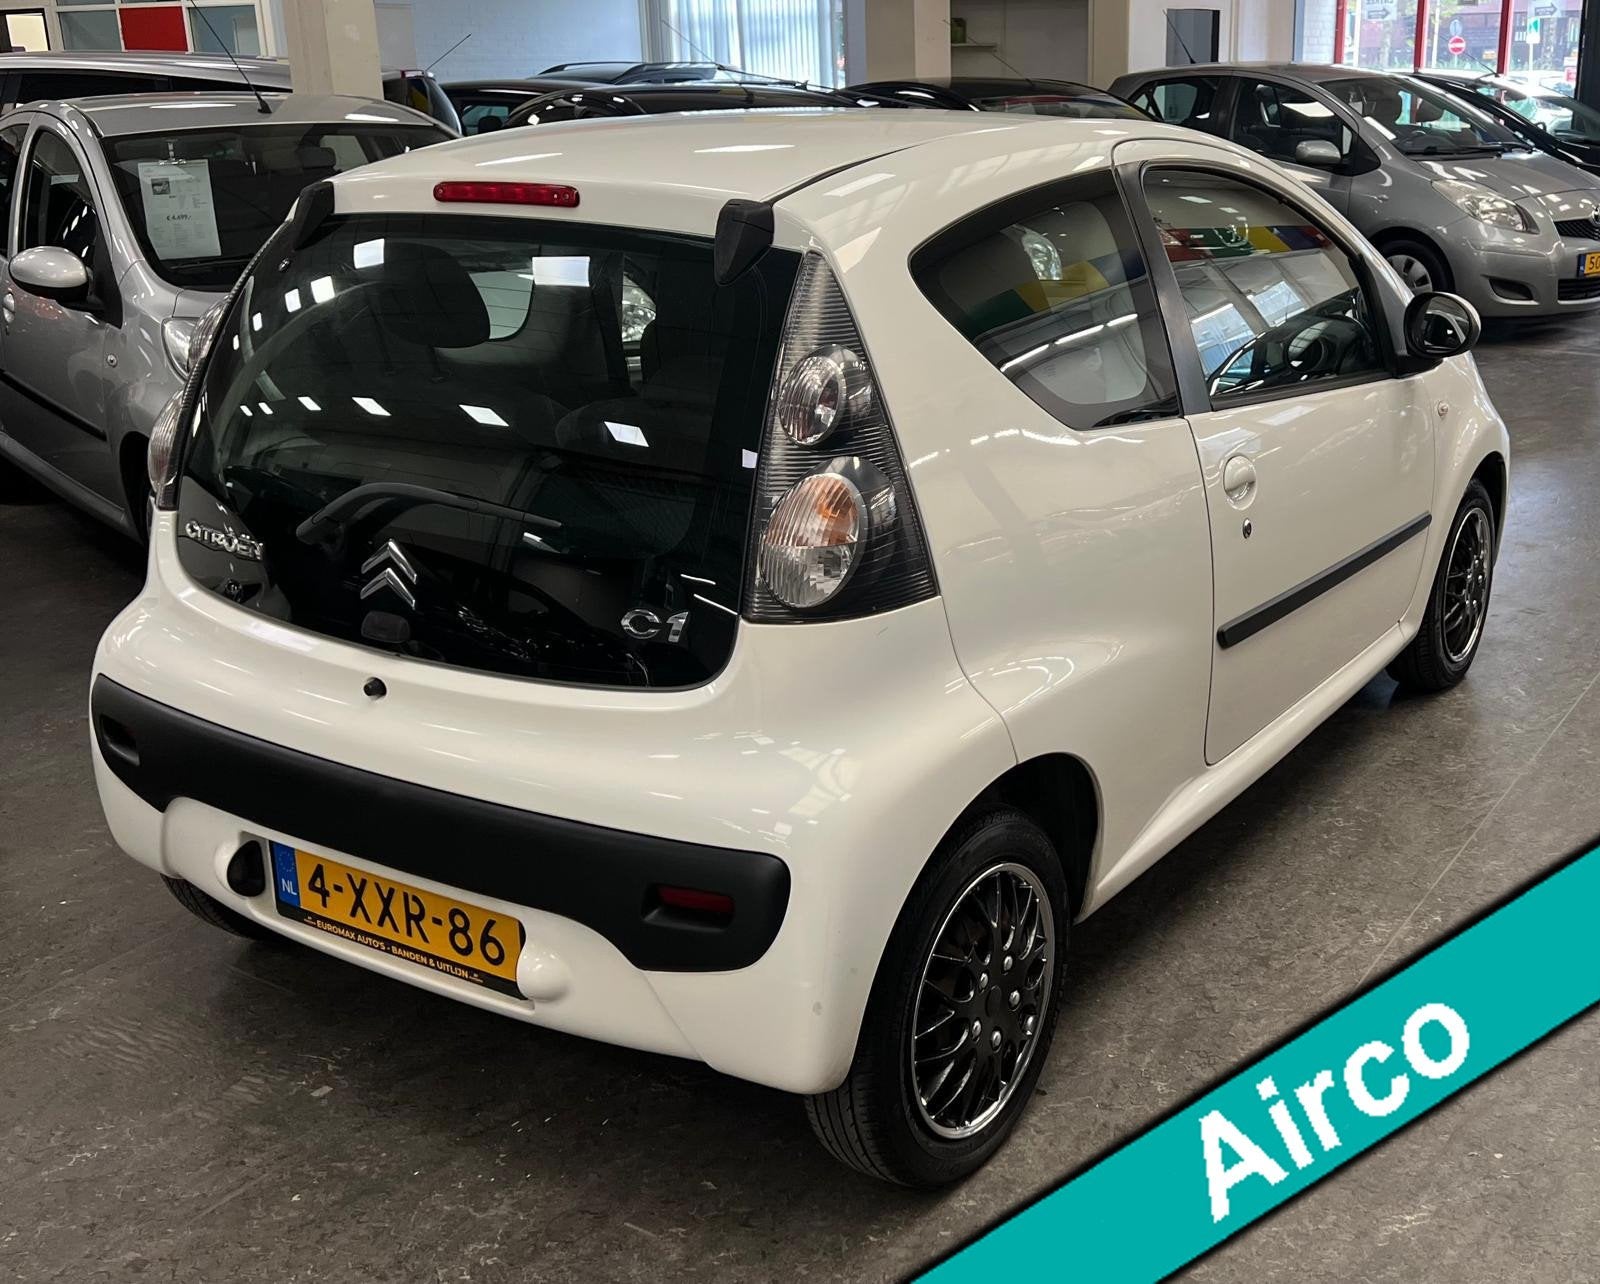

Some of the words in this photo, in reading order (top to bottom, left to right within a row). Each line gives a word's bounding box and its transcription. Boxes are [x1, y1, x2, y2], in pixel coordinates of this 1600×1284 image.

[620, 609, 689, 642] C1
[281, 878, 297, 896] NL
[308, 864, 505, 966] 4-XXR-86
[316, 920, 356, 941] EUROMAX
[357, 934, 386, 951] AUTO'S
[391, 945, 427, 965] BANDEN
[428, 958, 435, 967] &
